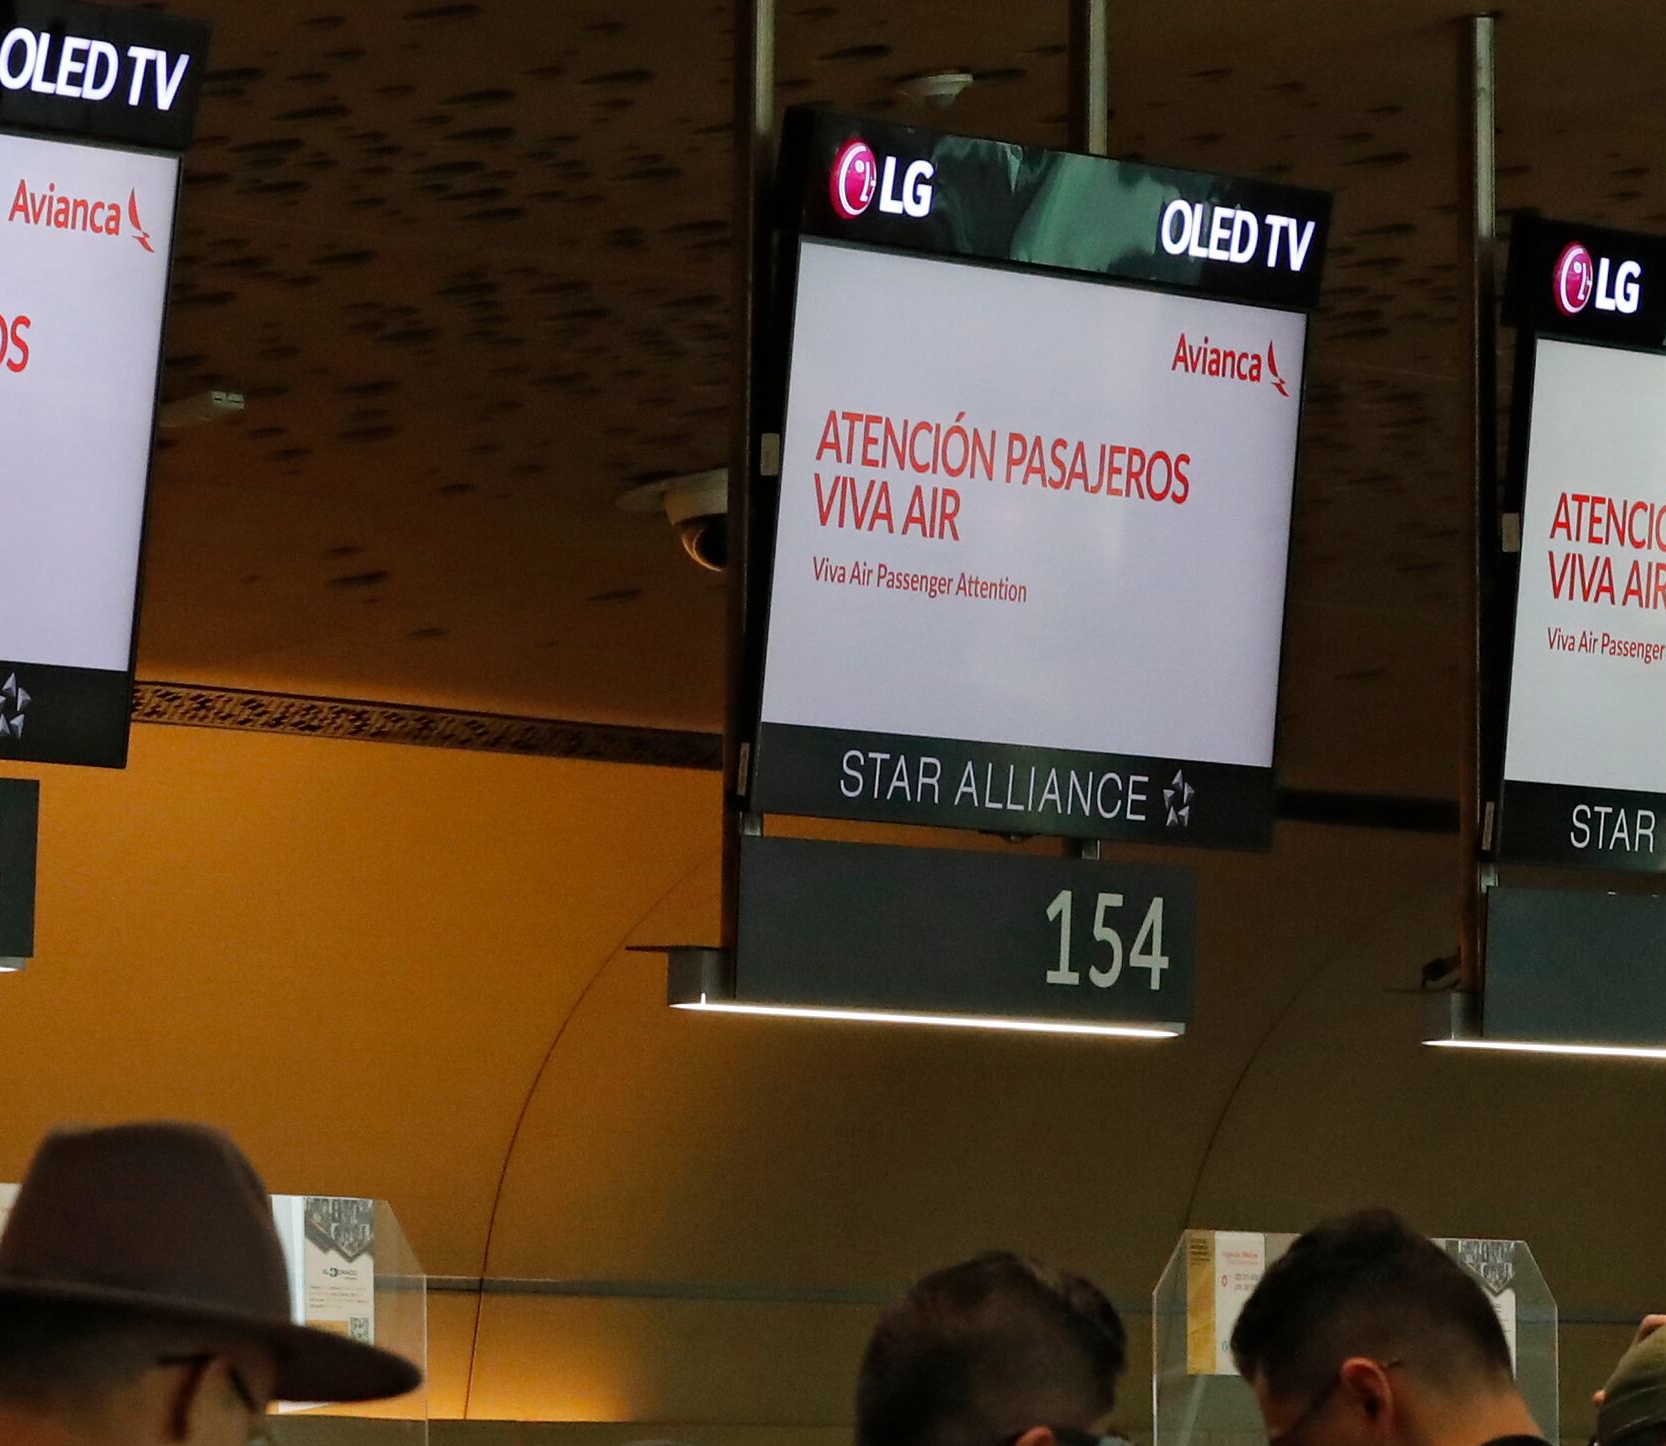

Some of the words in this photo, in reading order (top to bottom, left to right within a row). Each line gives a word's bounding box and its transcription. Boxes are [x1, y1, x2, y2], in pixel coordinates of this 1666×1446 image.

[127, 45, 191, 111] TV
[8, 179, 122, 237] Avianca
[879, 155, 934, 219] LG
[1162, 199, 1260, 267] OLED
[1264, 212, 1317, 273] TV
[1595, 257, 1641, 317] LG
[1171, 332, 1263, 386] Avianca
[815, 409, 996, 484] ATENCIÓN
[1005, 431, 1191, 506] PASAJEROS
[814, 472, 896, 536] VIVA
[901, 486, 961, 543] AIR
[812, 555, 847, 586] Viva
[849, 559, 874, 588] Air
[876, 562, 955, 600] Passenger
[955, 572, 1028, 604] Attention
[1548, 550, 1618, 608] VIVA
[1547, 627, 1576, 655] Viva
[1578, 630, 1598, 656] Air
[1600, 633, 1666, 666] Passenger
[840, 749, 940, 806] STAR
[954, 759, 1149, 824] ALLIANCE
[1570, 804, 1656, 855] STAR
[1044, 889, 1170, 992] 154
